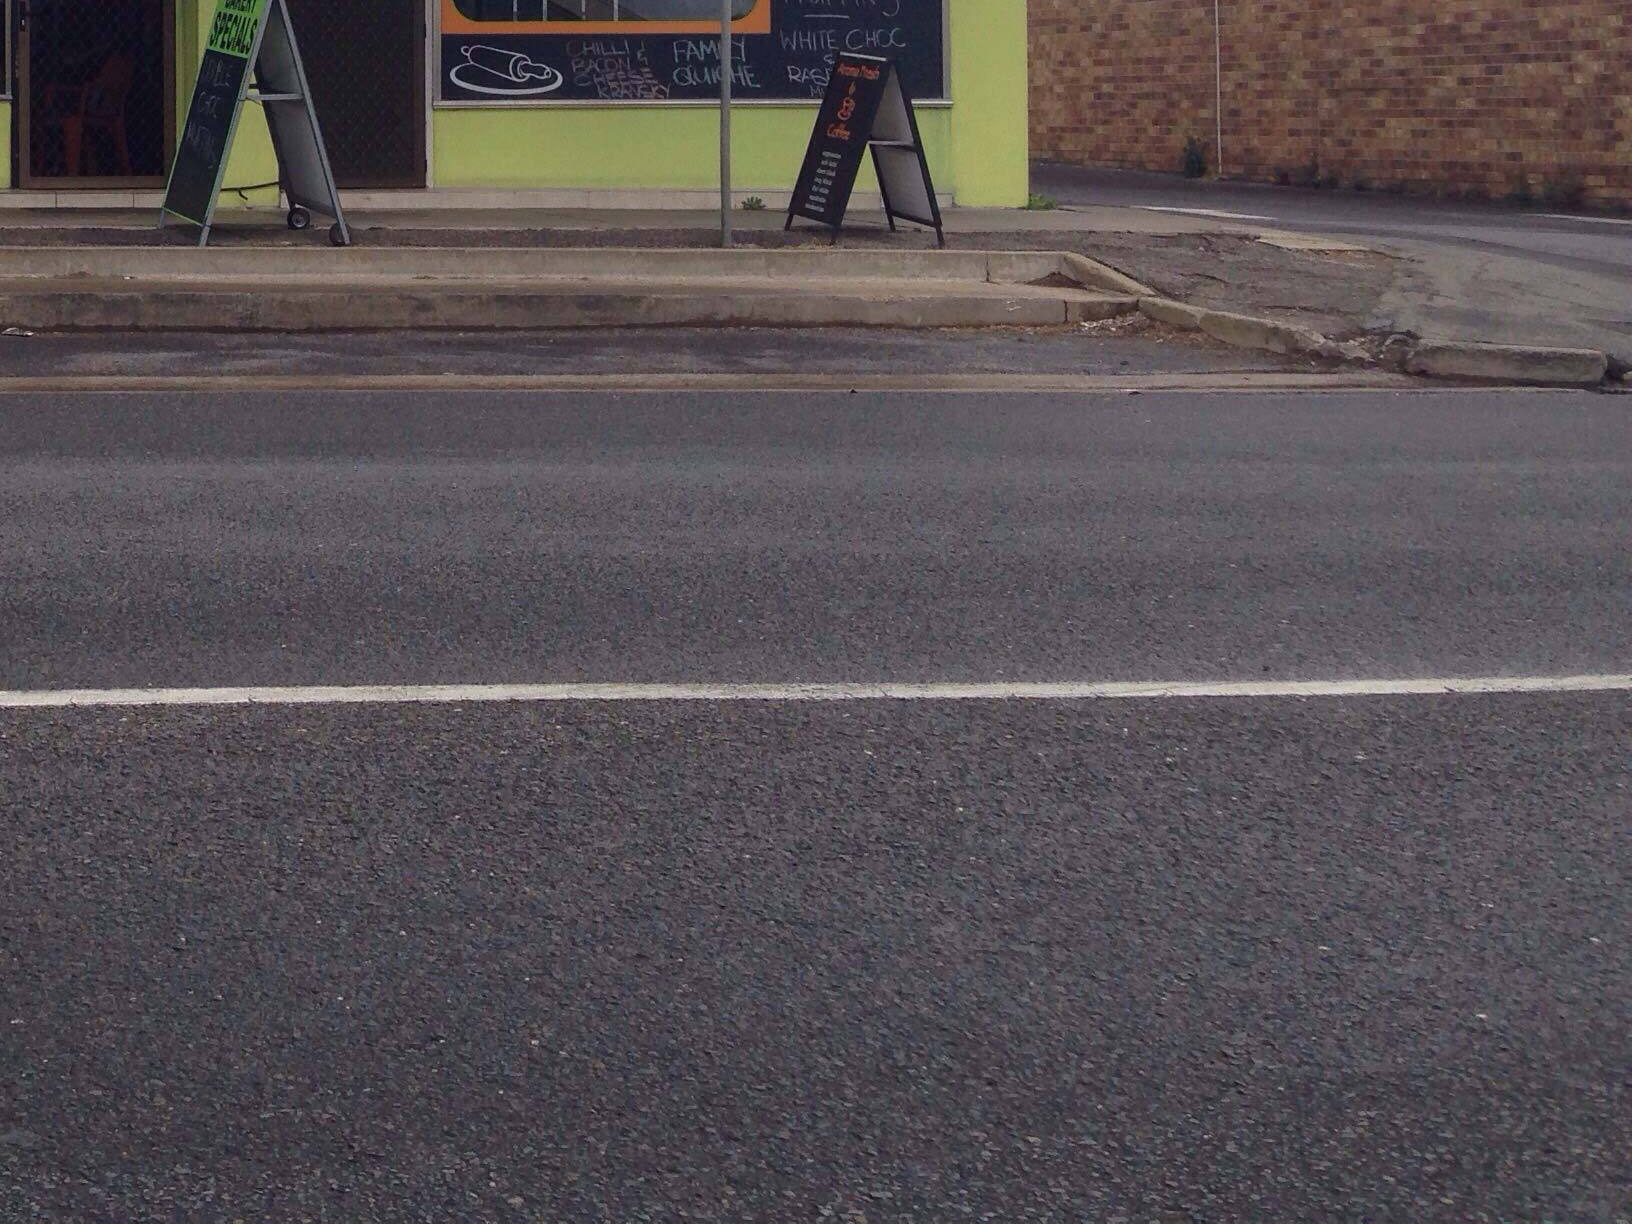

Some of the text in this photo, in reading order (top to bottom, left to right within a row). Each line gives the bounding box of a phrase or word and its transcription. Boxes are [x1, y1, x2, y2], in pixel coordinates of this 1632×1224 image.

[209, 11, 259, 55] SPECIALS
[780, 28, 906, 51] WHITE CHOC
[565, 39, 630, 58] CHILLI
[672, 37, 746, 64] FAMIY
